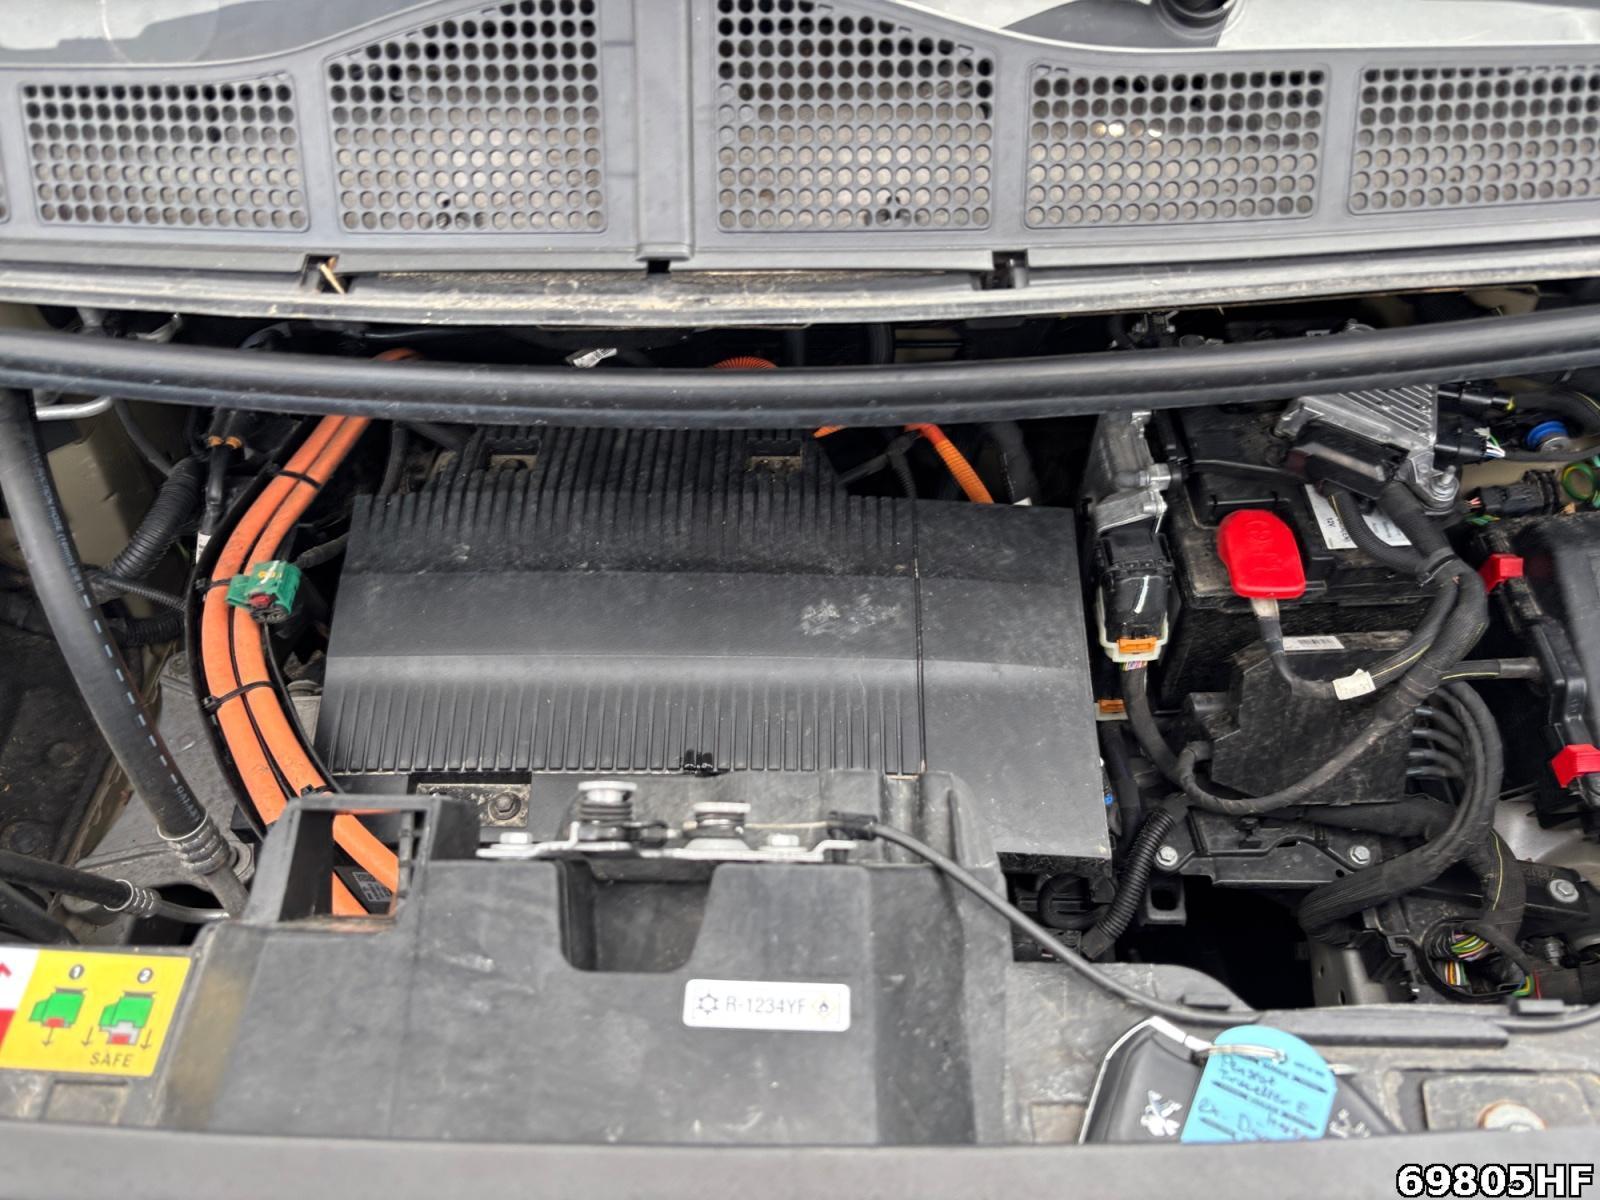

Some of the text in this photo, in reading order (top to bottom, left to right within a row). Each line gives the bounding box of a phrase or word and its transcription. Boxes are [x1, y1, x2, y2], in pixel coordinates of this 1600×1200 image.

[49, 505, 64, 533] HOSE
[726, 996, 806, 1014] R-1234YF
[90, 1052, 134, 1067] SAFE
